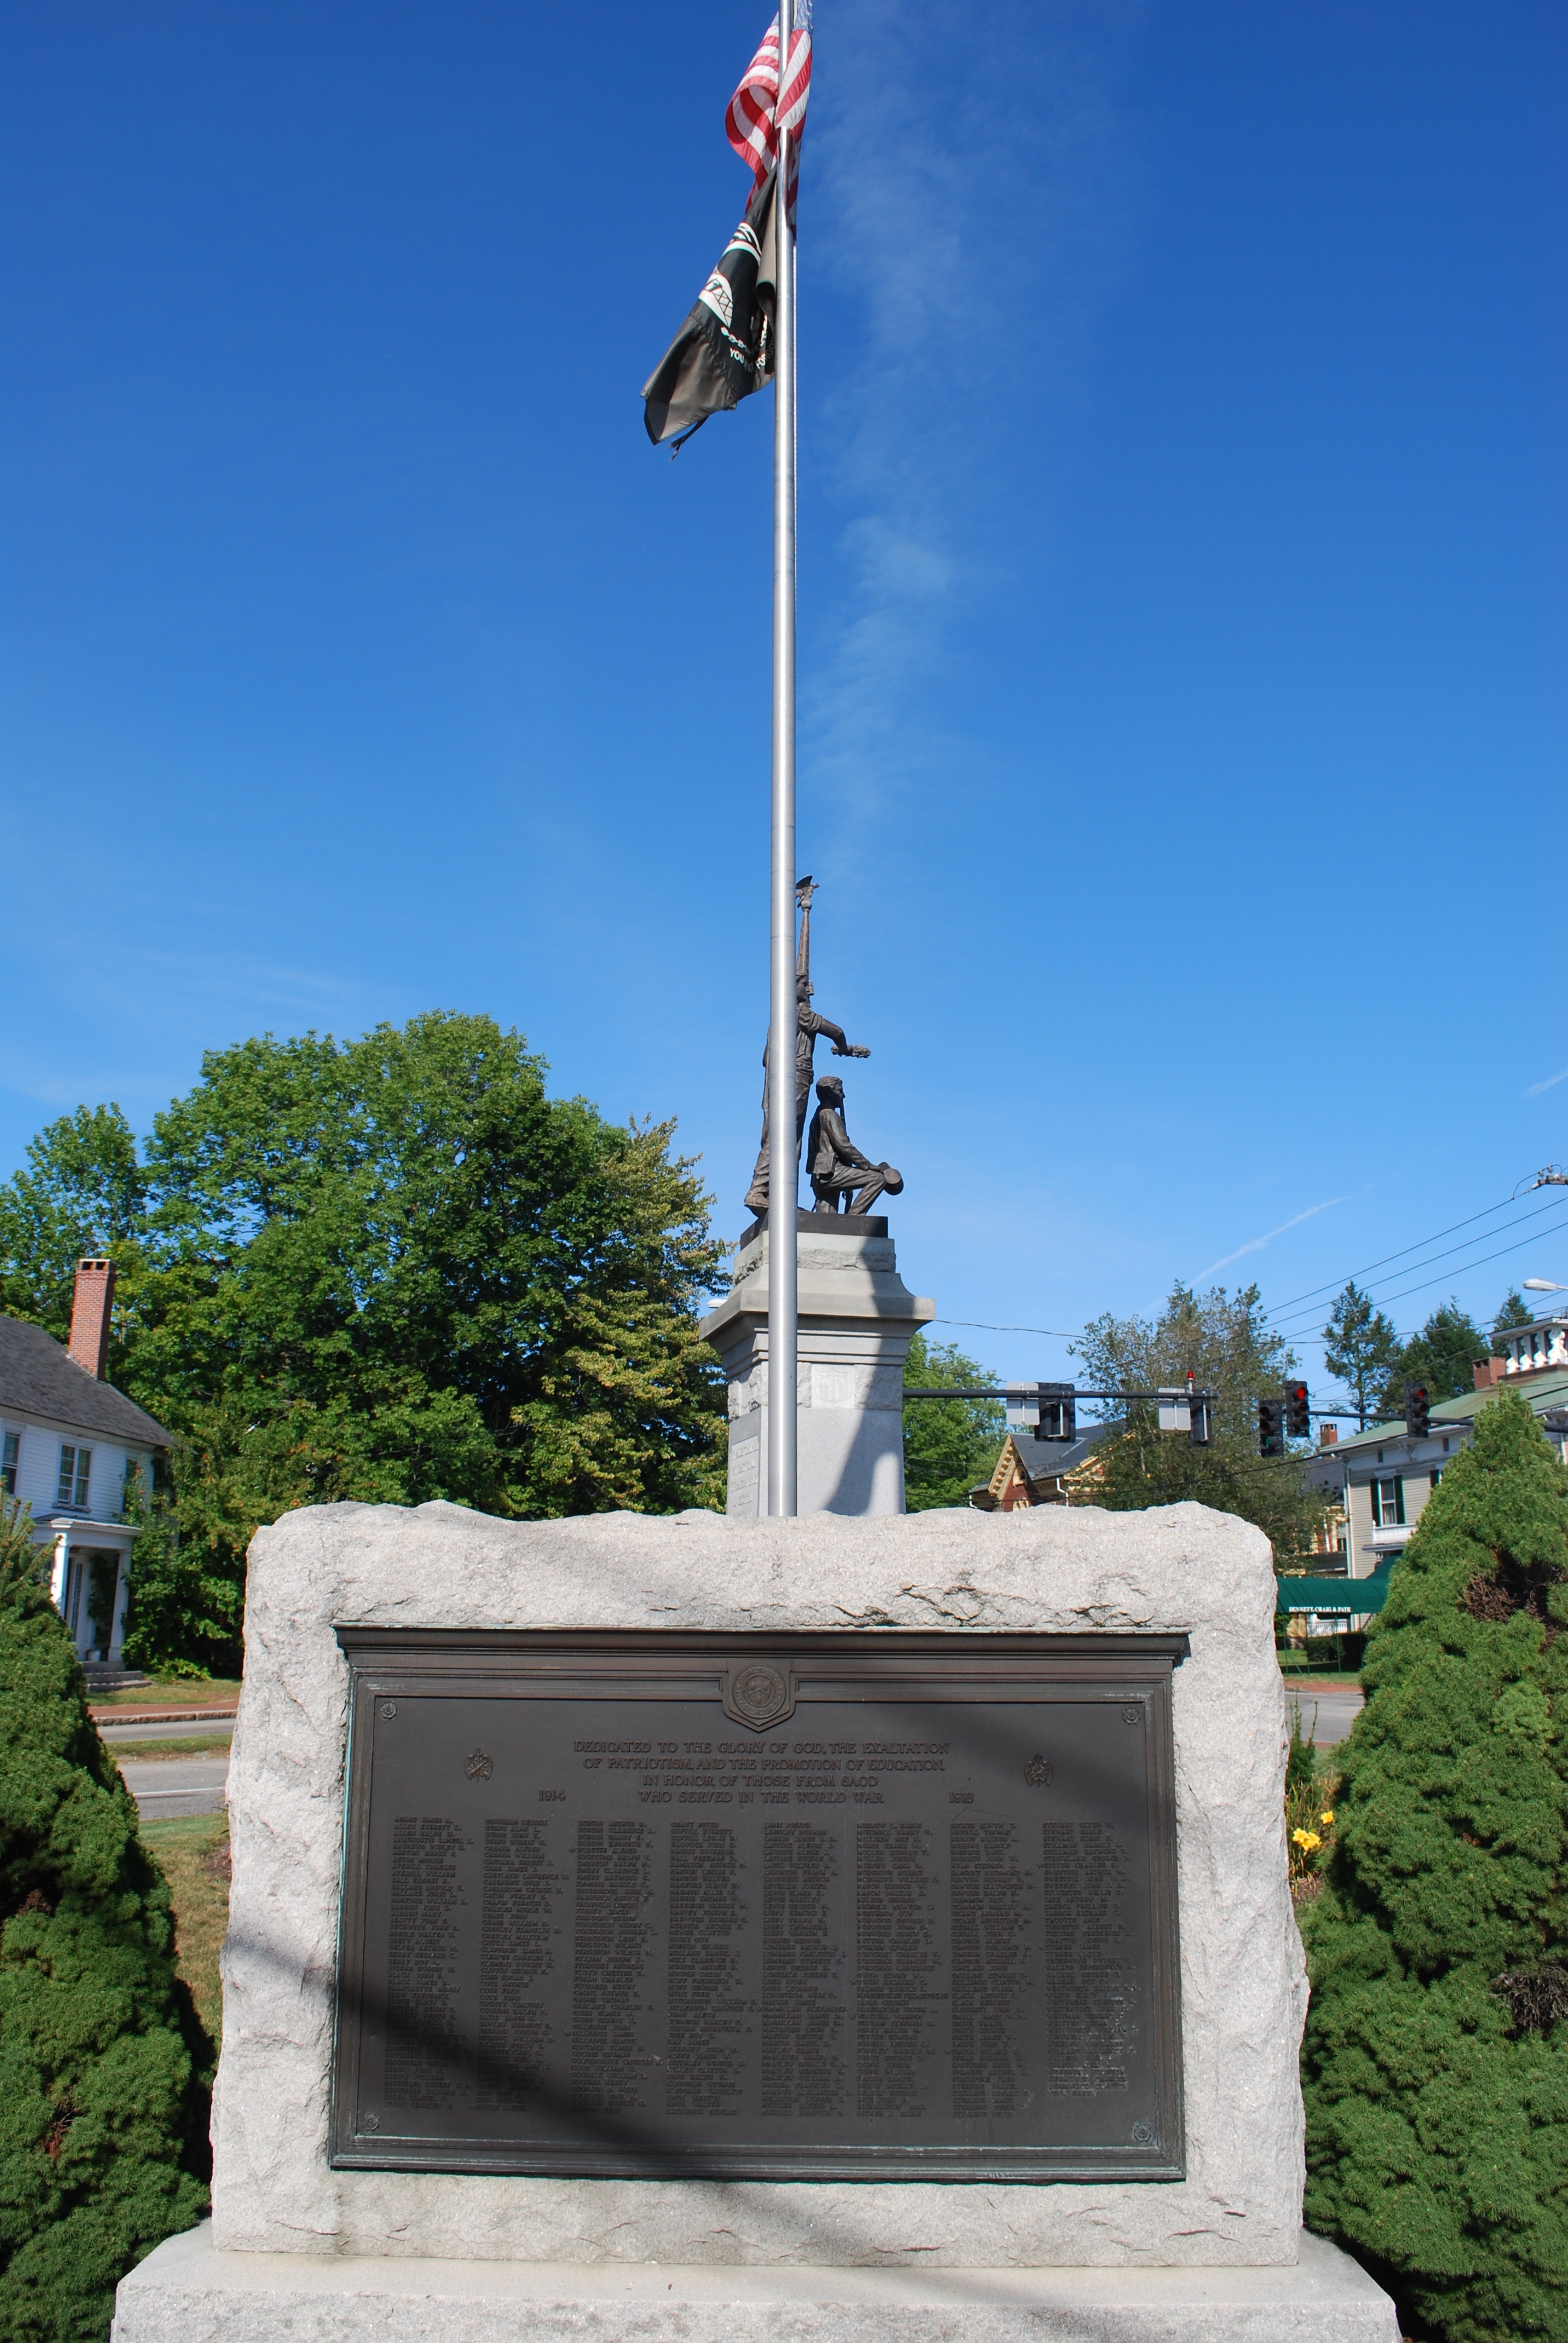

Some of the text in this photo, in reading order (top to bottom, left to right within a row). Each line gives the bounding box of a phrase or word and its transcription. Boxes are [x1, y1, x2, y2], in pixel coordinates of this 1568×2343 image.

[730, 347, 745, 364] YOU
[575, 1740, 652, 1752] DEDICATED
[658, 1742, 678, 1753] TO
[684, 1742, 711, 1754] THE
[717, 1742, 766, 1754] GLORY
[769, 1742, 788, 1754] OF
[829, 1742, 856, 1754] THE
[863, 1742, 950, 1754] EXALTATION
[583, 1757, 603, 1769] OF
[696, 1758, 726, 1771] AND
[730, 1758, 756, 1770] THE
[762, 1758, 841, 1771] PROMOTION
[847, 1759, 864, 1771] OF
[643, 1774, 878, 1787] IN HONOR OF THOSE FROM SACO
[539, 1789, 566, 1801] 1914
[639, 1790, 885, 1804] WHO SERVED IN THE WORLD WAR
[949, 1791, 975, 1803] 1918
